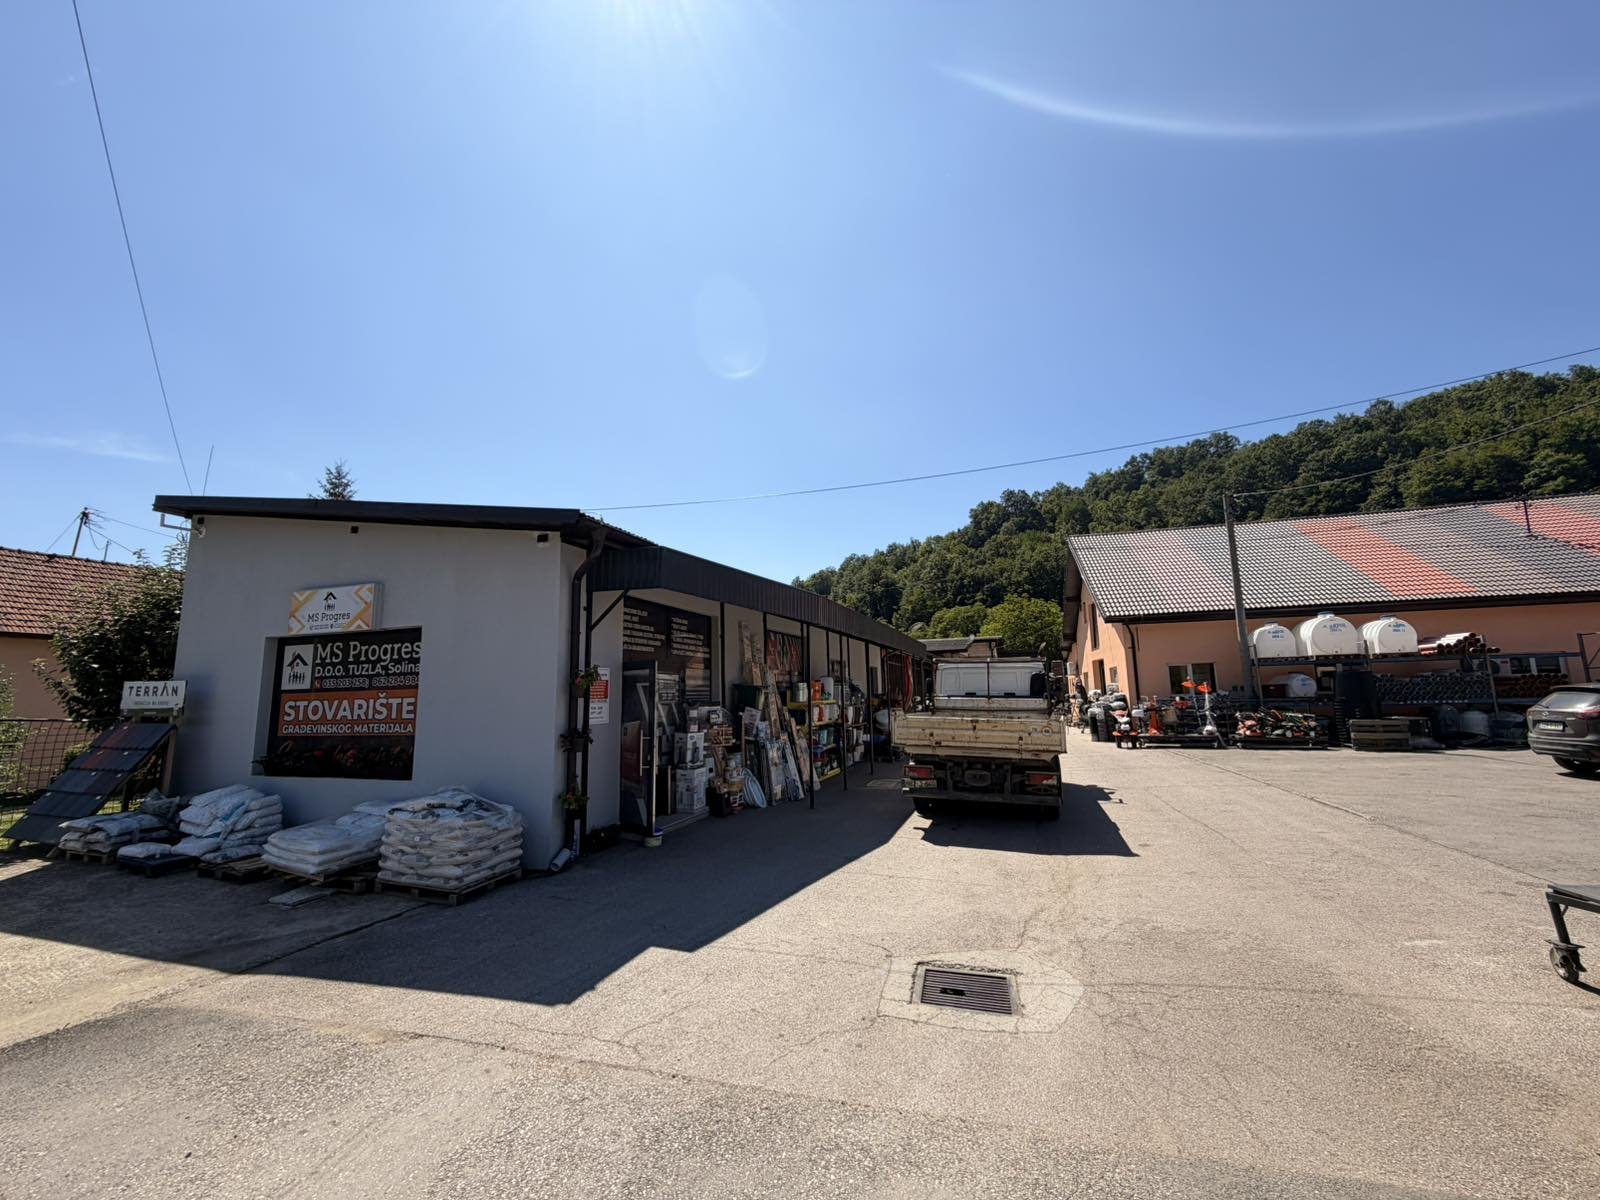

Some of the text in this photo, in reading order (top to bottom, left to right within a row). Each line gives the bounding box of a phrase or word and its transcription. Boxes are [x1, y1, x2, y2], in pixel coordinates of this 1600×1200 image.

[307, 612, 351, 623] MS Progres
[315, 641, 421, 666] MS Progres
[315, 665, 345, 677] D.O.O.
[348, 663, 385, 676] TUZLA,
[405, 674, 420, 685] 98
[283, 692, 416, 722] STOVARIŠTE
[282, 722, 414, 735] GRAĐEVINSKOG MATERIJALA
